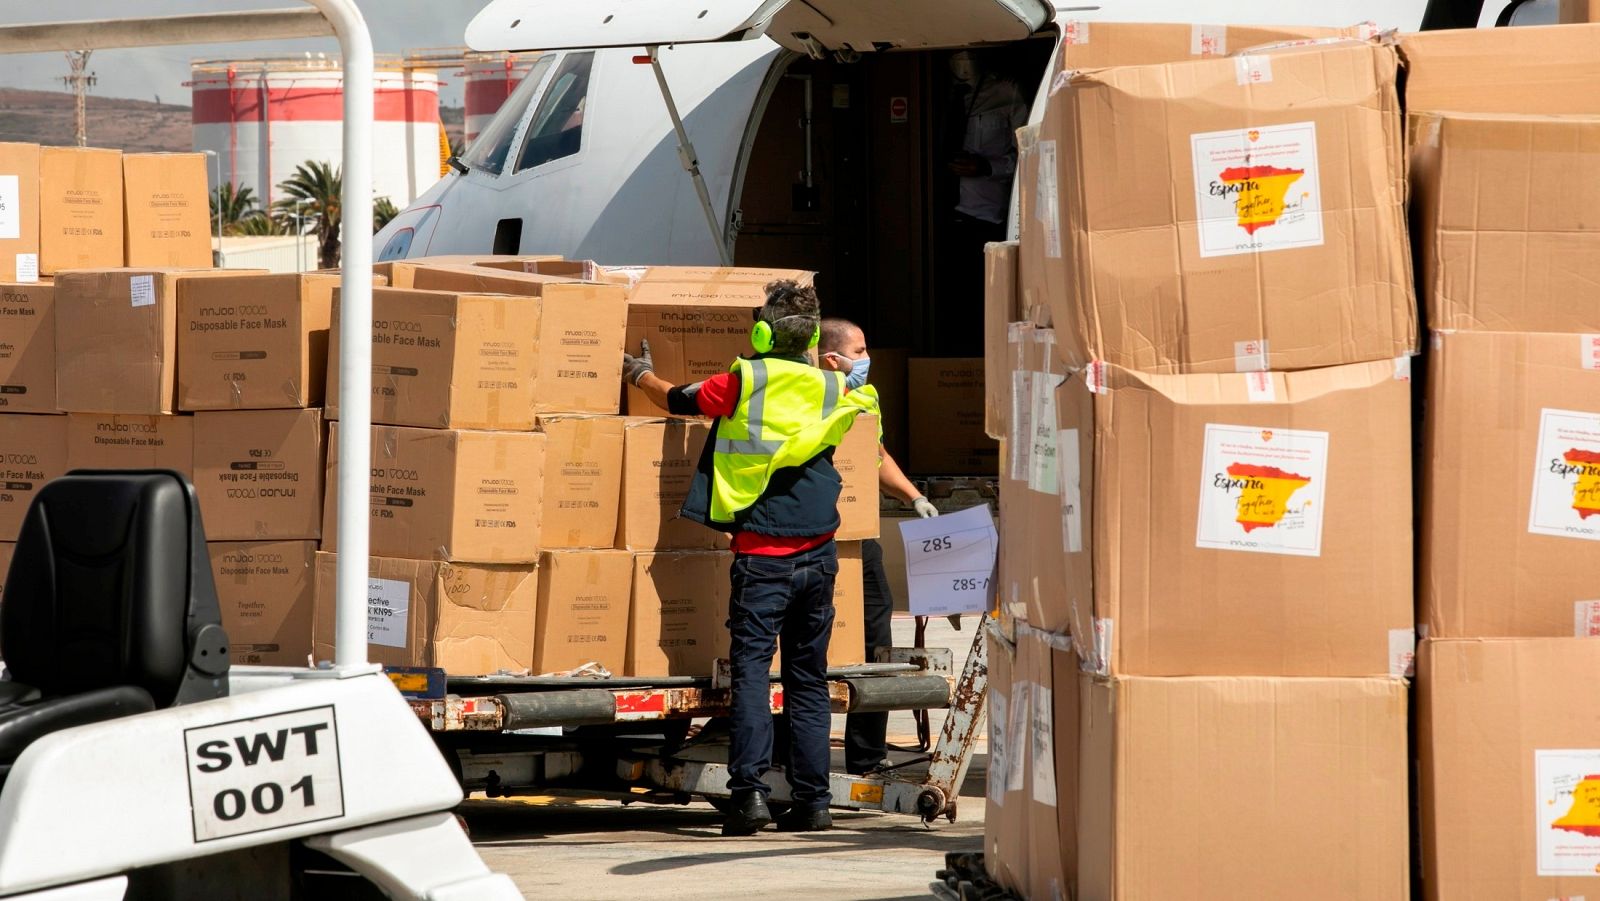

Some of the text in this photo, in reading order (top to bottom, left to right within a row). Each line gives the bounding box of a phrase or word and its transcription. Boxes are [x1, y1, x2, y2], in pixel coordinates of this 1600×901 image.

[190, 318, 287, 333] Disposable Face Mask
[659, 325, 748, 335] Disposable Face Mask
[393, 335, 415, 346] Face
[417, 336, 441, 348] Mask
[232, 372, 246, 381] FDA
[382, 387, 395, 396] FDA
[95, 436, 164, 447] Disposable Face Mask
[6, 470, 45, 480] Face Mask
[219, 472, 299, 482] Mask Face Disposable
[1214, 473, 1264, 493] España
[387, 485, 404, 495] Face
[406, 486, 426, 497] Mask
[380, 509, 394, 518] FDA
[922, 535, 952, 553] 582
[220, 566, 289, 576] Disposable Face Mask
[373, 607, 393, 617] KN95
[196, 722, 329, 773] SWT
[213, 774, 316, 822] 001
